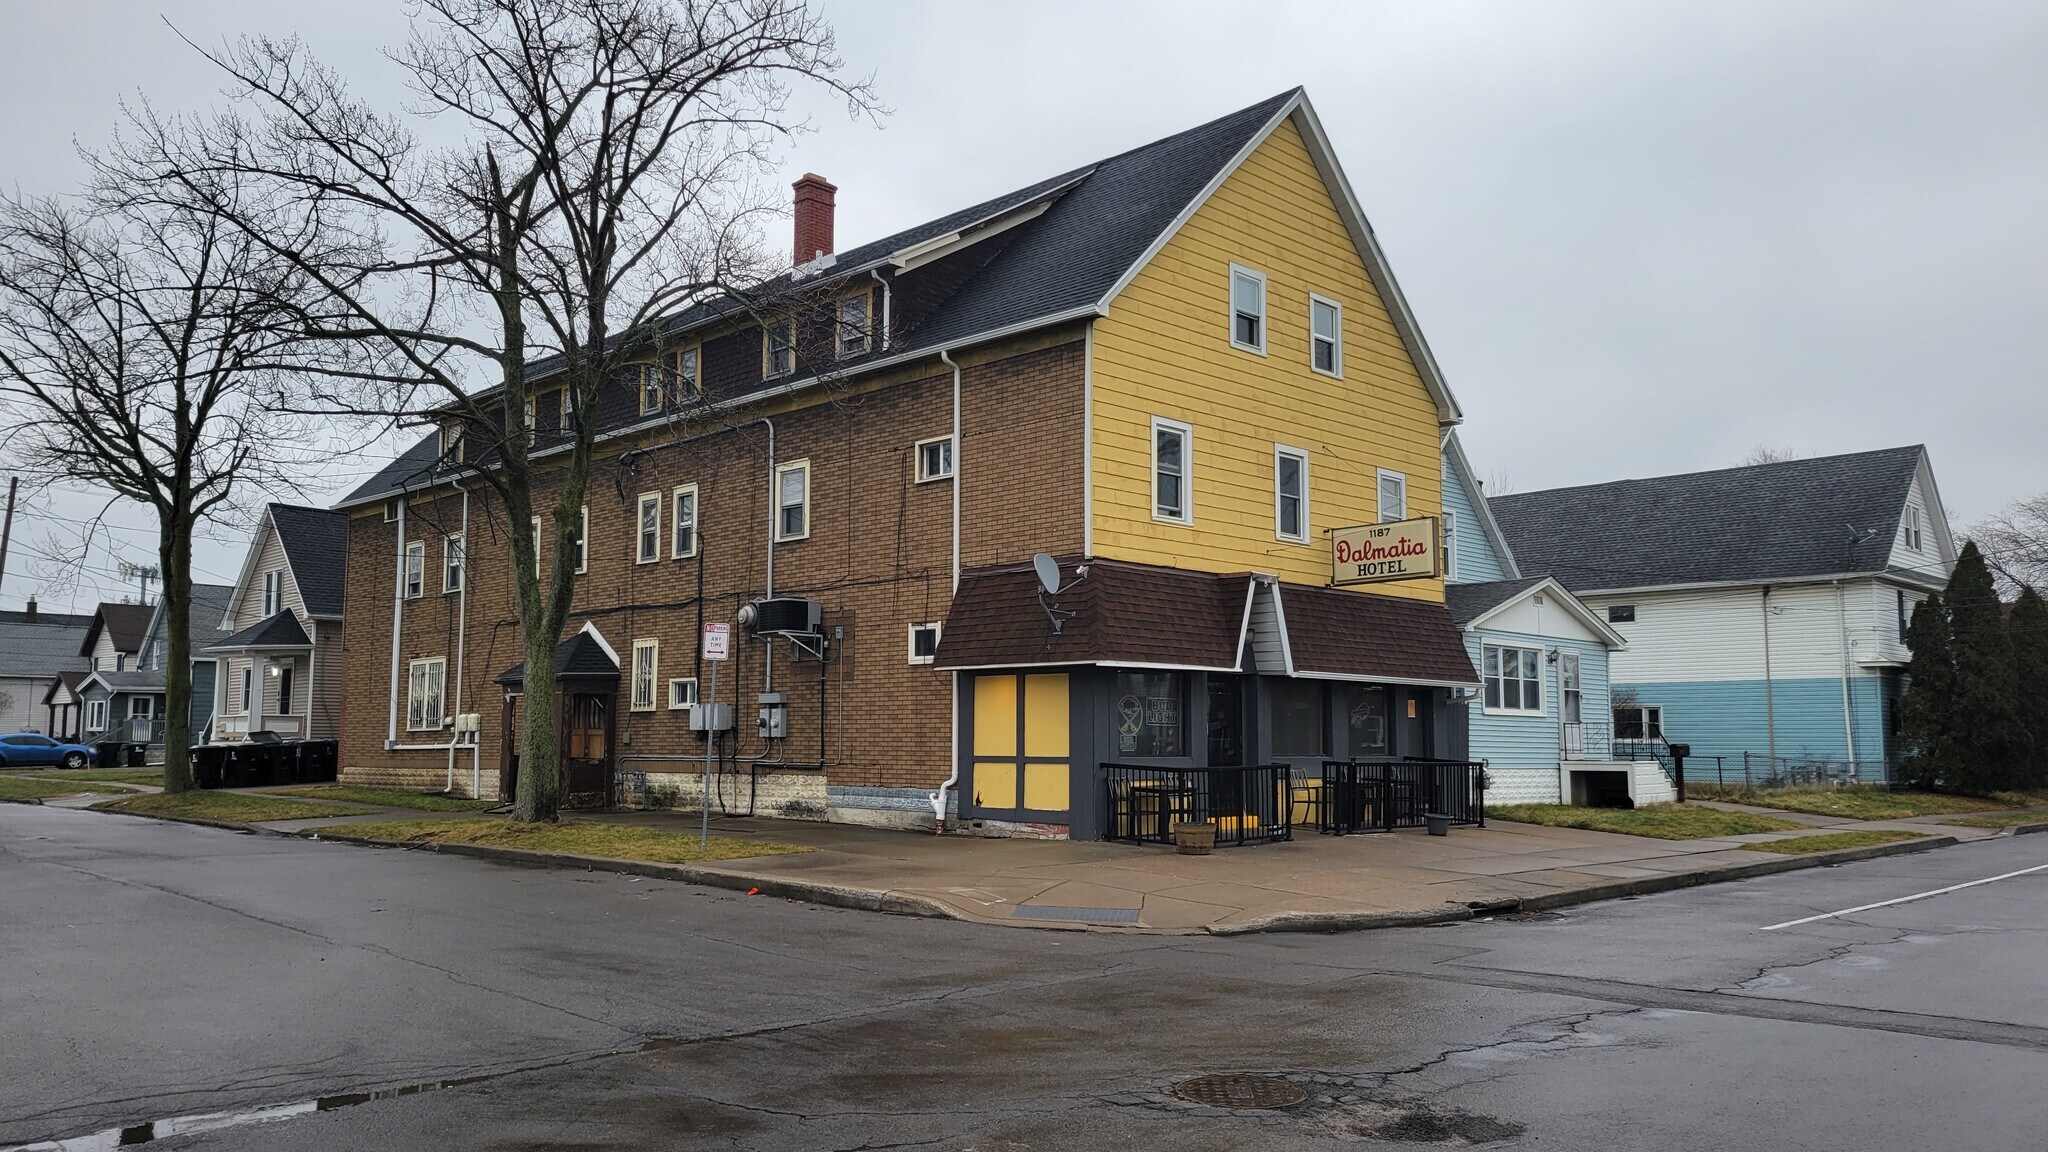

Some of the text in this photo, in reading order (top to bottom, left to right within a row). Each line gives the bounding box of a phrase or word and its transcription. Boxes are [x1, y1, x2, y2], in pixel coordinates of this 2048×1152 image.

[1369, 528, 1390, 538] 1187
[1336, 536, 1427, 564] Dalmatia
[1357, 560, 1407, 577] HOTEL
[1152, 700, 1172, 712] BUD
[1147, 711, 1177, 723] LIGHT
